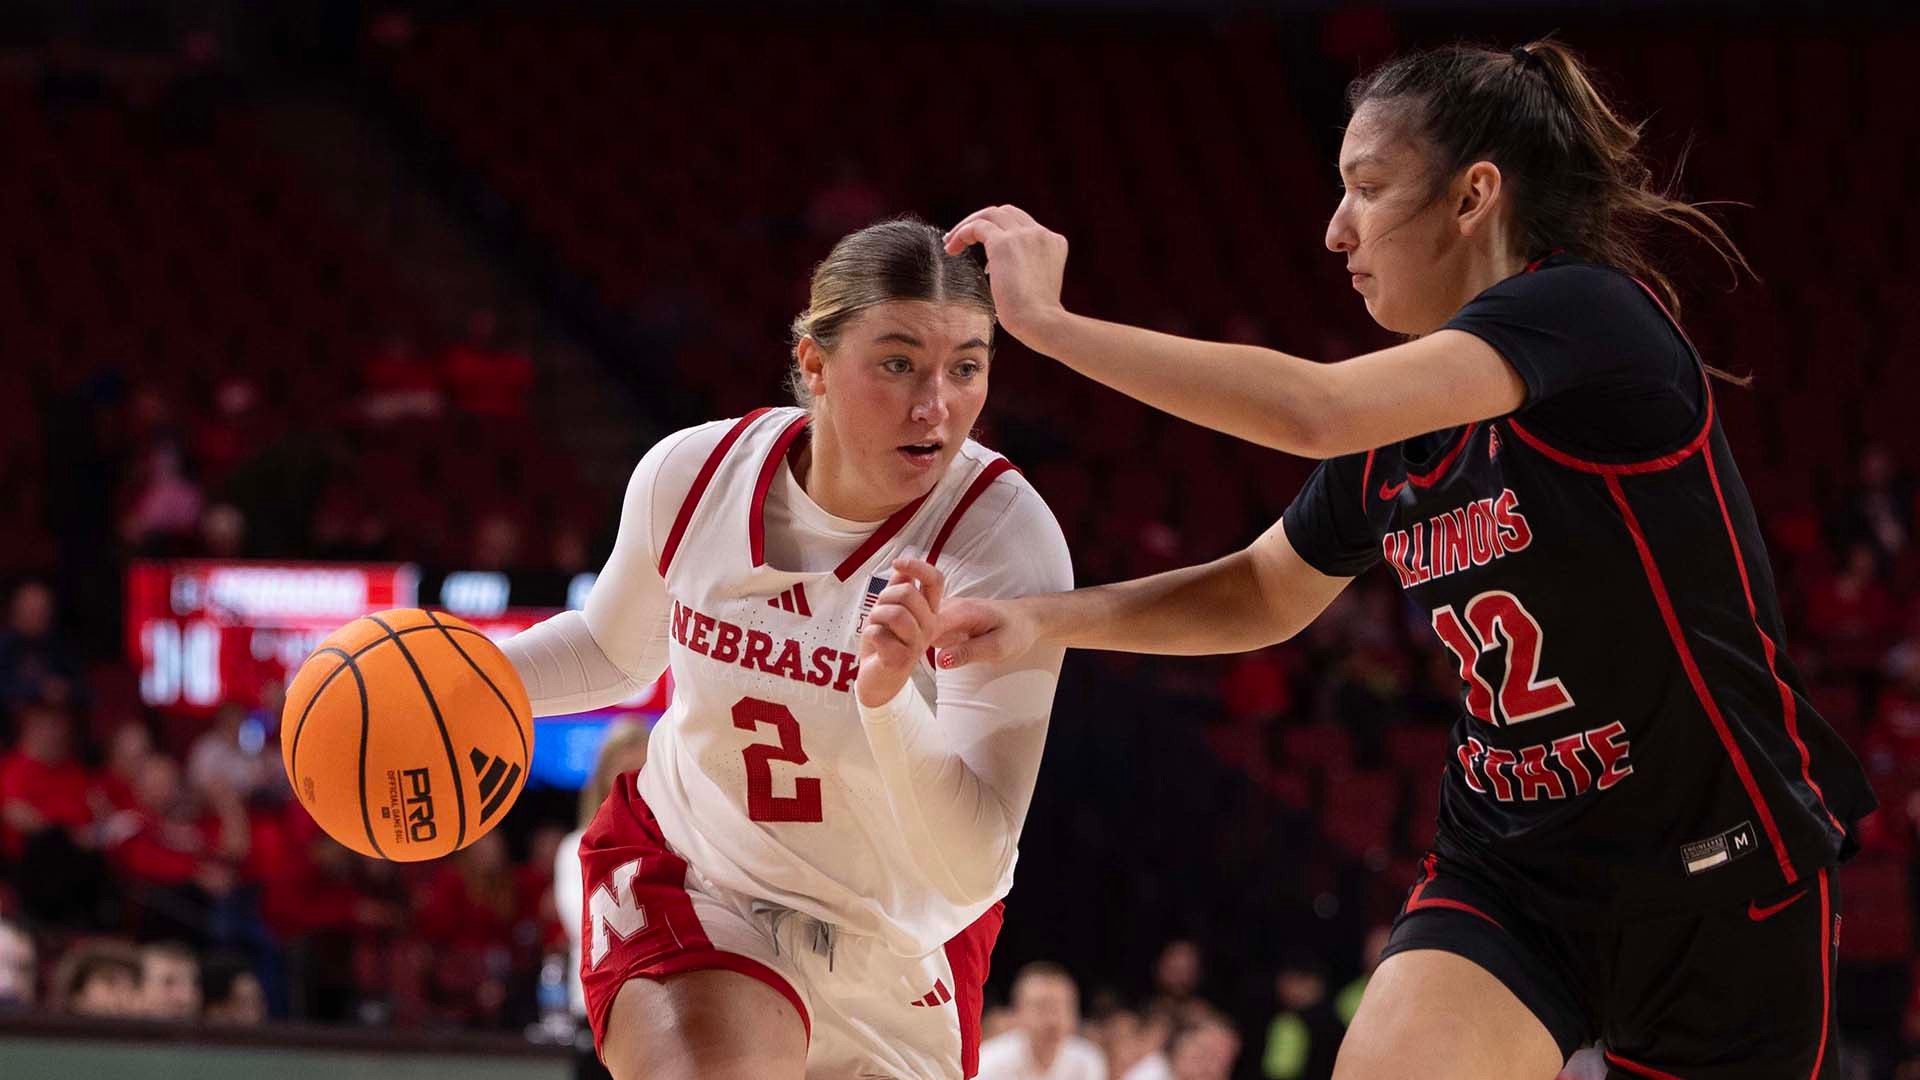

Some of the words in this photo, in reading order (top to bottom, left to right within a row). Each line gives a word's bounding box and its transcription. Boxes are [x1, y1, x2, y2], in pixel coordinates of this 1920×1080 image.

[1383, 488, 1533, 589] ILLINOIS
[672, 599, 861, 693] NEBRASK
[1432, 590, 1575, 727] 12
[403, 768, 437, 842] PRO
[731, 696, 824, 823] 2
[1734, 832, 1749, 850] M
[589, 857, 649, 972] N
